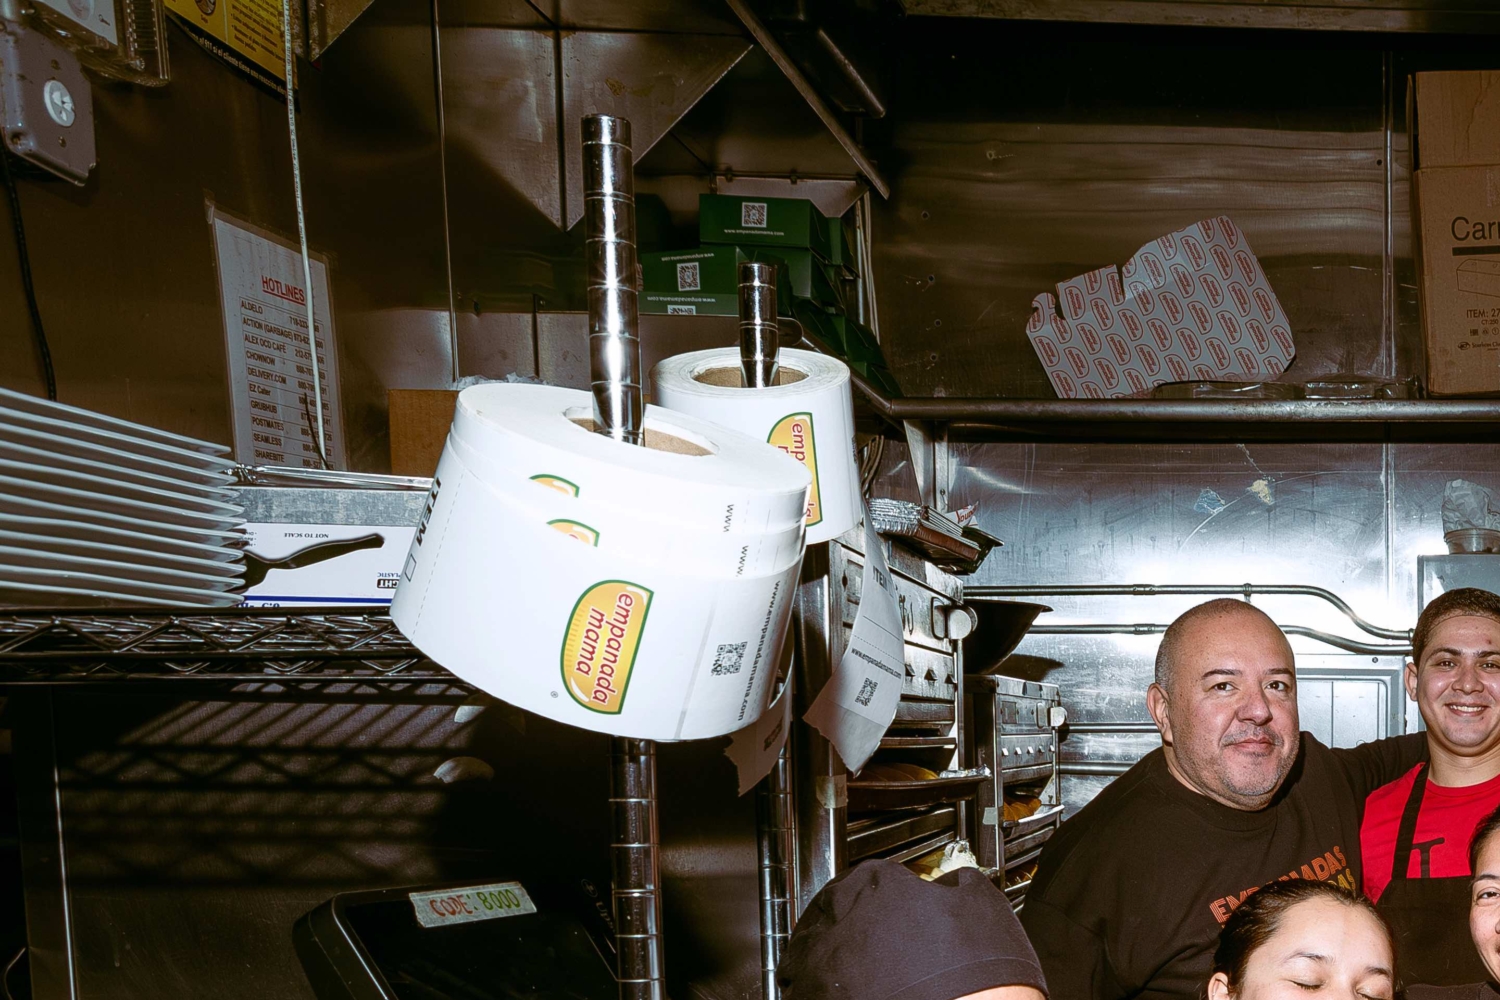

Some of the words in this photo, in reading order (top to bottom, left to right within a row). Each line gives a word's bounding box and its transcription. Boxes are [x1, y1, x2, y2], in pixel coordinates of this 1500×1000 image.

[261, 274, 305, 302] HOTLINES
[241, 300, 263, 314] ALDELO
[1466, 309, 1489, 318] ITEM:
[243, 317, 263, 331] ACTION
[264, 323, 293, 342] (GARBAGE)
[244, 333, 259, 345] ALEX
[246, 350, 276, 366] CHOWNOW
[247, 367, 287, 384] DELIVERY.COM
[249, 383, 256, 392] EZ
[250, 400, 278, 414] GRUBHUB
[252, 416, 285, 431] POSTMATES
[253, 433, 283, 447] SEAMLESS
[255, 449, 285, 463] SHAREBITE
[416, 477, 442, 547] ITEM
[378, 579, 400, 589] GHT
[575, 607, 606, 676] mama
[592, 592, 634, 704] empanada
[737, 580, 781, 722] www.empanadamama.com
[479, 888, 521, 911] 8000
